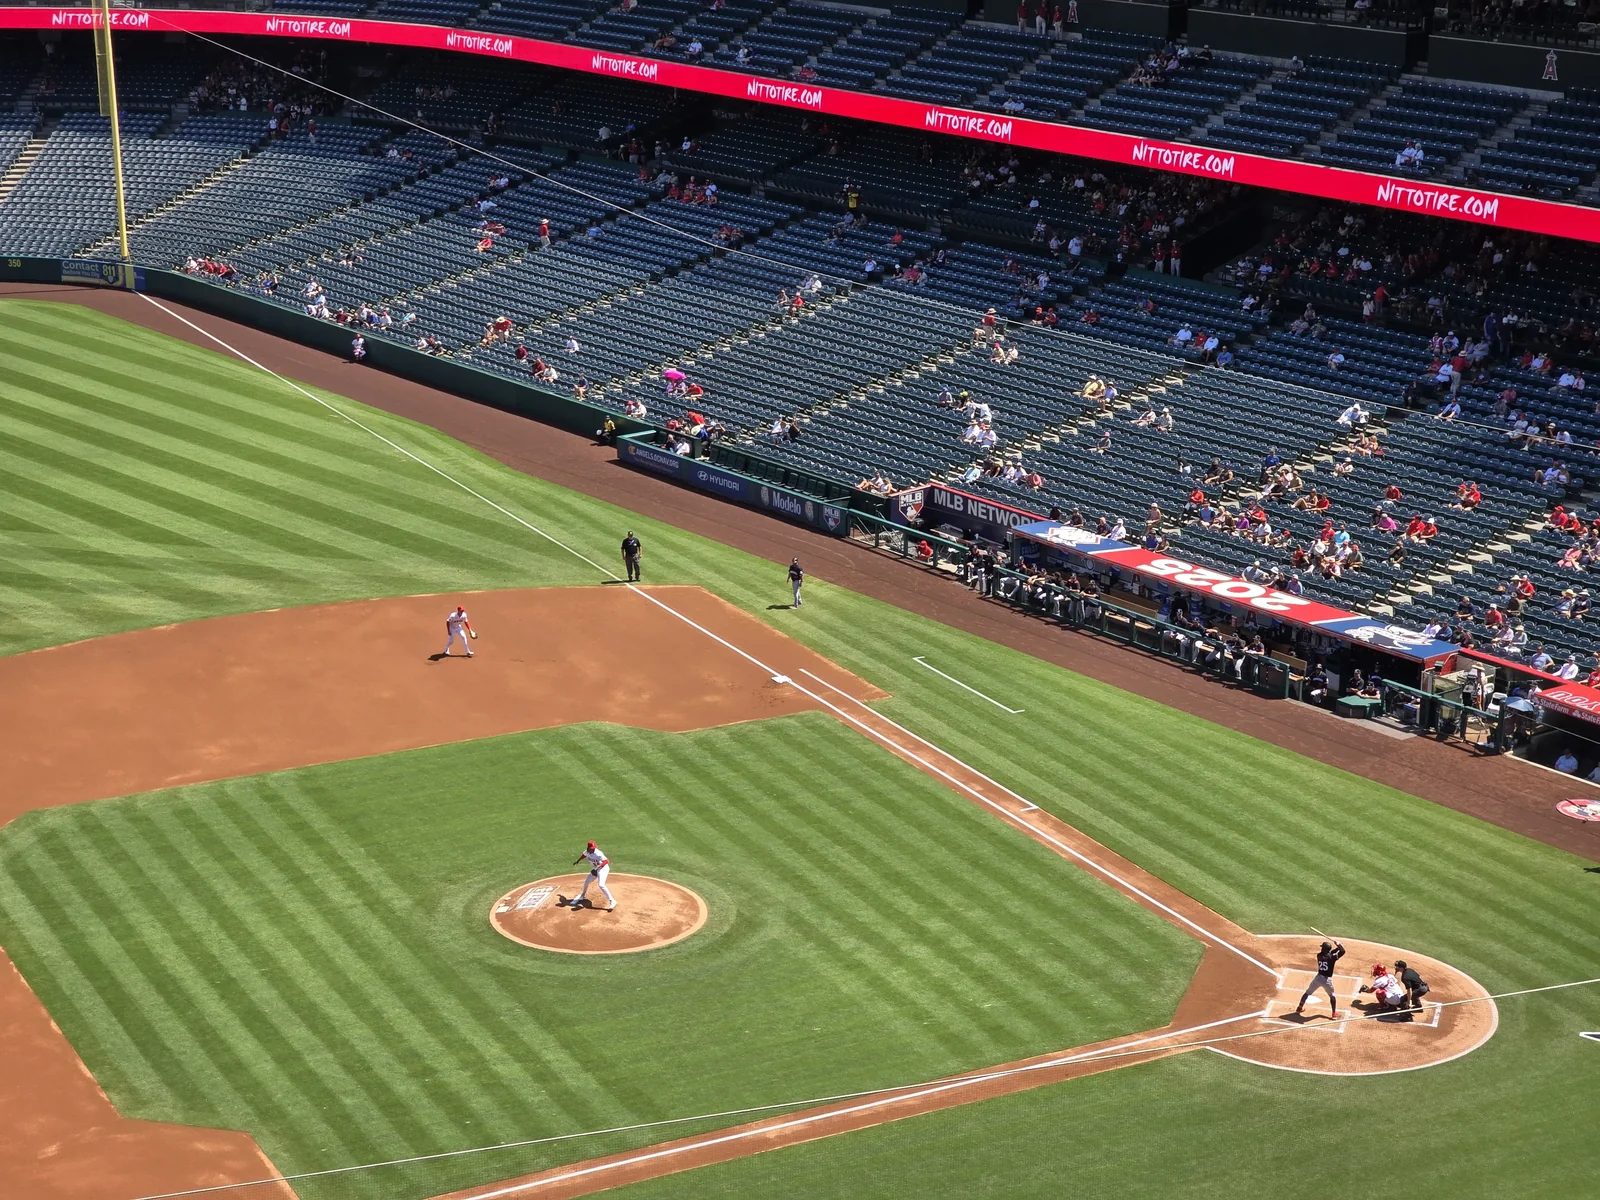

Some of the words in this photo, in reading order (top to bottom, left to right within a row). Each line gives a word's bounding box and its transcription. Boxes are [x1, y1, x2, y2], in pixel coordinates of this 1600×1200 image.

[266, 17, 350, 37] NITTOTIRE.COM
[446, 31, 513, 54] NITTOTIRE.COM
[592, 54, 658, 79] NITTOTIRE.COM
[747, 80, 822, 107] NITTOTIRE.COM
[925, 107, 1013, 141] NITTOTIRE.COM
[1132, 142, 1235, 177] NITTOTIRE.COM
[1377, 180, 1499, 221] NITTOTIRE.COM
[7, 259, 22, 268] 350
[62, 260, 99, 272] Contact
[102, 264, 116, 277] 811
[709, 474, 740, 491] HYUNDAI
[772, 490, 801, 515] Modelo
[900, 492, 922, 504] MLB
[934, 489, 964, 511] MLB
[967, 498, 1036, 528] NETWOR
[824, 506, 839, 517] MLB
[1137, 558, 1311, 611] 2025
[1318, 960, 1329, 972] 25
